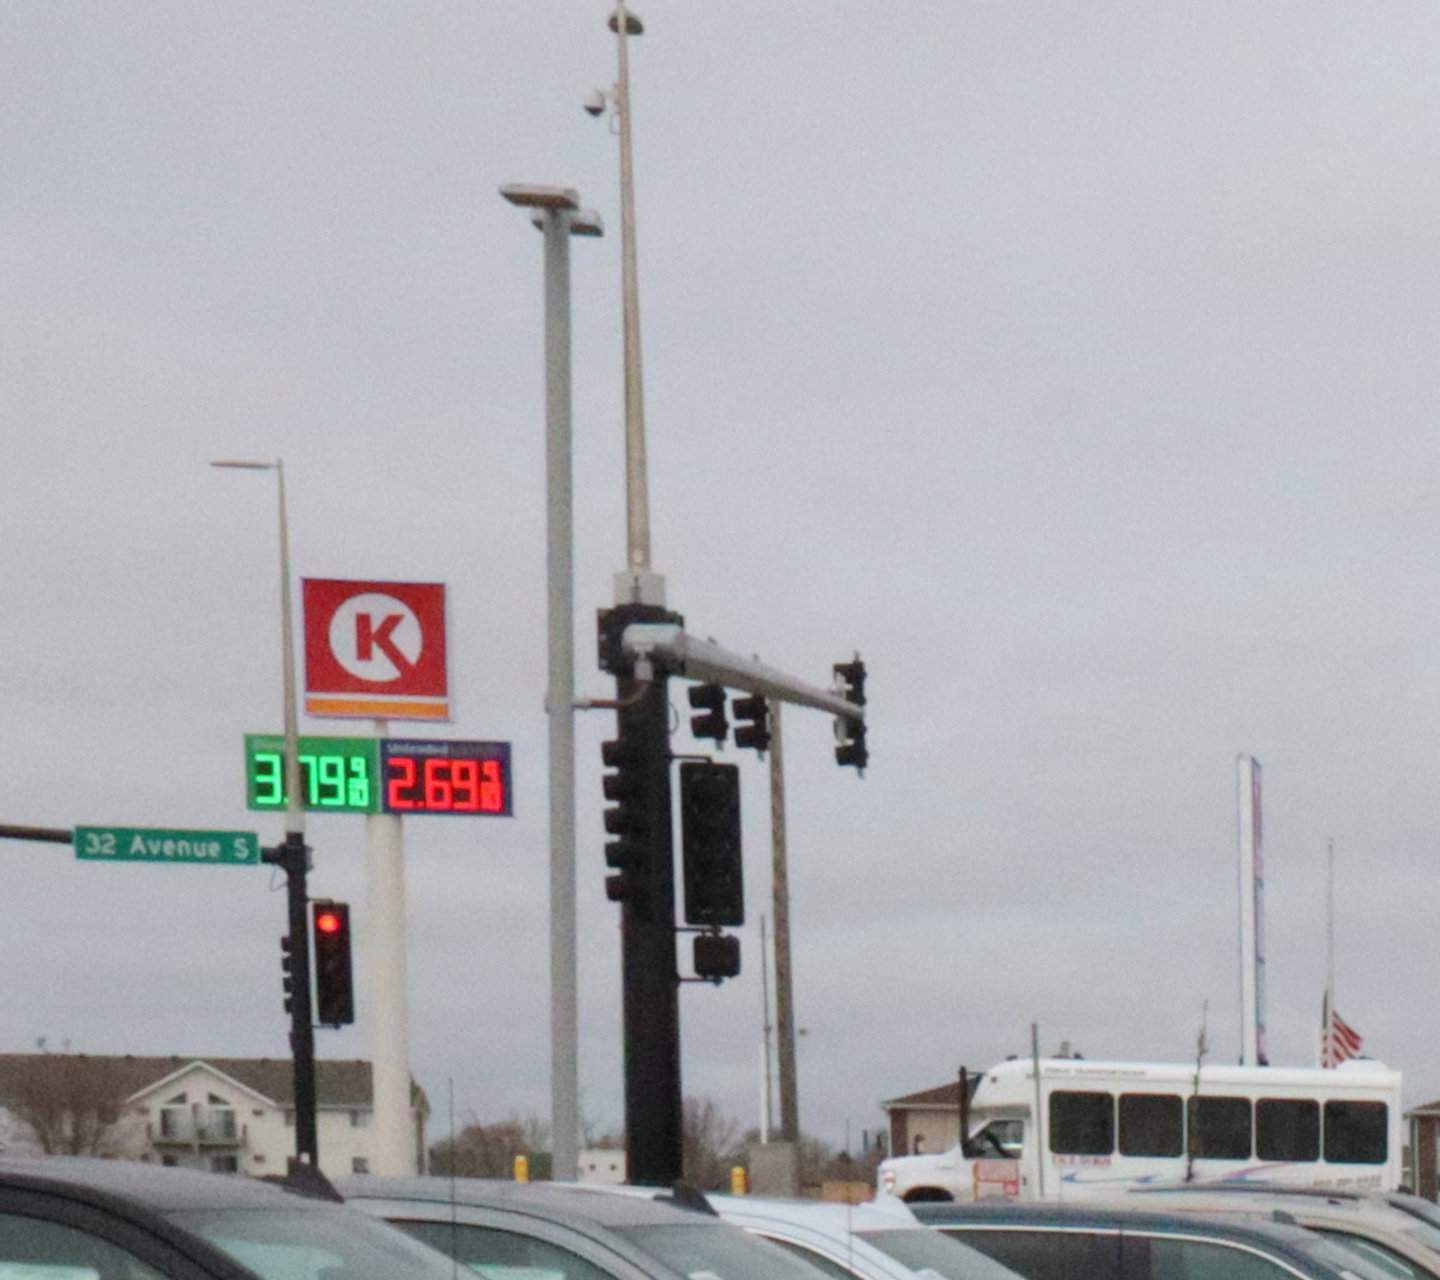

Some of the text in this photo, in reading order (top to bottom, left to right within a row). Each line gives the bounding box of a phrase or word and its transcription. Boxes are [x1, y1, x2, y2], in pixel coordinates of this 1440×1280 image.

[85, 832, 250, 860] 32 Avenue S
